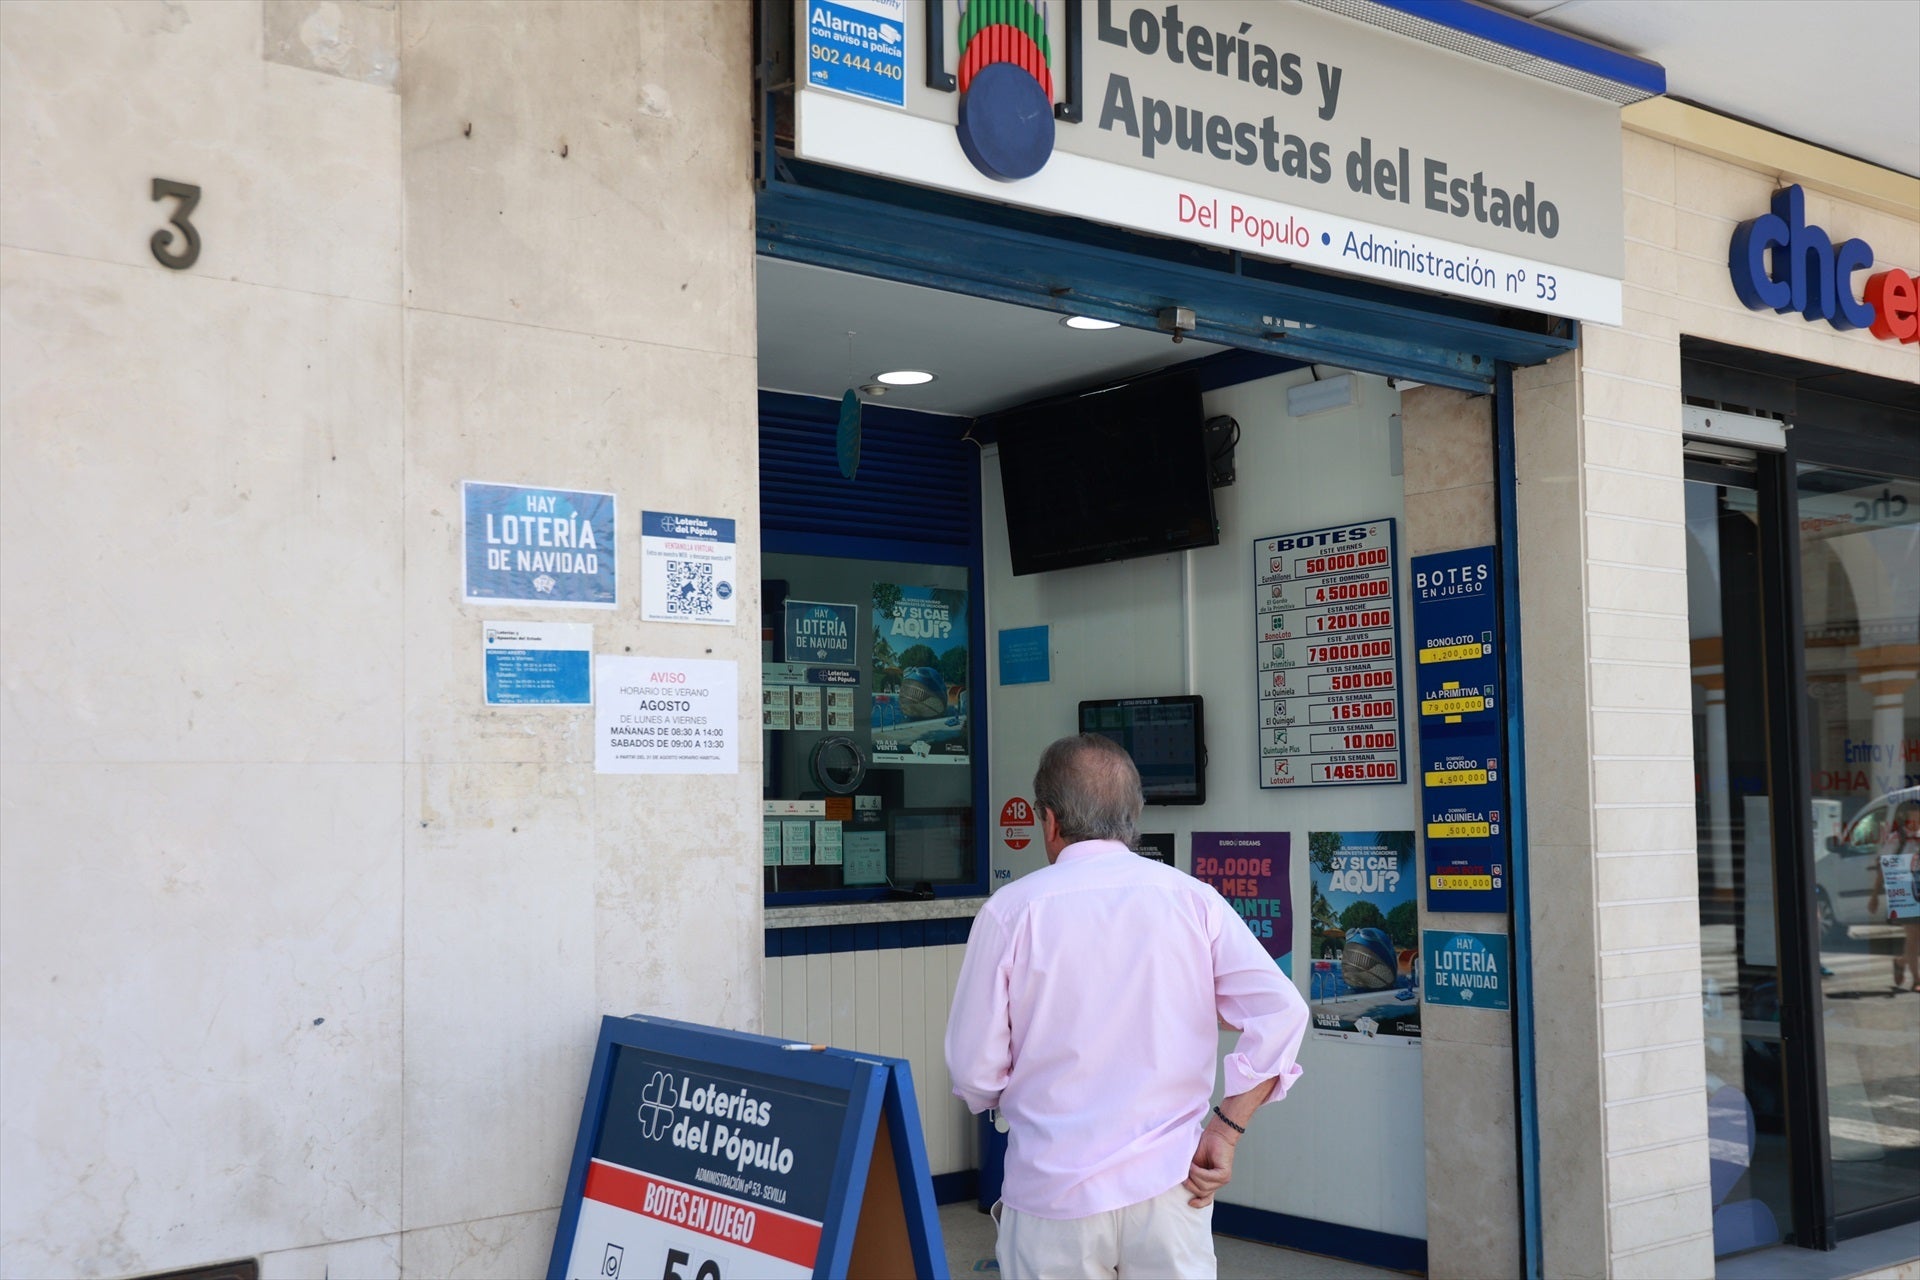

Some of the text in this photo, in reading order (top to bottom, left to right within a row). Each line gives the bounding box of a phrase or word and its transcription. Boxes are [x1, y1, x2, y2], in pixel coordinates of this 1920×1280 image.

[812, 8, 878, 41] Alarma
[811, 27, 831, 38] con
[833, 31, 860, 46] aviso
[862, 40, 868, 48] a
[811, 44, 902, 80] 902 444 440
[1098, 0, 1343, 121] Loterías y
[1099, 73, 1560, 239] Apuestas del Estado
[150, 178, 202, 270] 3
[1179, 194, 1558, 301] Del Populo Administración nº 53
[1728, 184, 1876, 332] chc
[526, 494, 556, 513] HAY
[486, 511, 597, 549] LOTERÍA
[675, 526, 688, 534] del
[1277, 528, 1367, 552] BOTES
[1320, 543, 1363, 556] ESTE VIERNES
[488, 549, 598, 575] DE NAVIDAD
[1339, 573, 1370, 582] DOMINGO
[1416, 564, 1488, 589] BOTES
[1422, 582, 1482, 598] EN JUEGO
[814, 609, 828, 618] HAY
[893, 606, 949, 620] ¿Y SI CAE
[1345, 603, 1366, 611] NOCHE
[796, 617, 847, 636] LOTERÍA
[890, 617, 952, 639] AQUÍ?
[796, 636, 848, 649] DE NAVIDAD
[1327, 633, 1369, 643] ESTE JUEVES
[1427, 634, 1474, 648] BONOLOTO
[1344, 663, 1372, 671] SEMANA
[650, 672, 686, 684] AVISO
[620, 686, 709, 697] HORARIO DE VERANO
[1272, 688, 1295, 696] Quiniela
[1345, 694, 1372, 702] SEMANA
[1426, 687, 1479, 700] LA PRIMITIVA
[640, 700, 690, 711] AGOSTO
[620, 715, 707, 725] DE LUNES A VIERNES
[1346, 723, 1374, 731] SEMANA
[610, 725, 723, 737] MAÑANAS DE 08:30 A 14:00
[610, 738, 724, 748] SABADOS DE 09:00 A 13:30
[1434, 760, 1477, 770] EL GORDO
[1006, 801, 1027, 820] +18
[1432, 811, 1484, 822] LA QUINIELA
[1196, 857, 1272, 877] 20.000€
[1331, 857, 1397, 870] ¿Y SI CAE
[994, 869, 1011, 879] VISA
[1329, 870, 1400, 894] AQUÍ?
[1222, 878, 1258, 897] MES
[1456, 939, 1473, 949] HAY
[1435, 948, 1497, 973] LOTERÍA
[1435, 972, 1498, 989] DE NAVIDAD
[679, 1077, 772, 1127] Loterias
[672, 1116, 794, 1174] del Pópulo
[695, 1167, 744, 1192] ADMINISTRACIÓN
[752, 1183, 761, 1196] 53
[763, 1185, 787, 1204] SEVILLA
[643, 1182, 756, 1244] BOTES EN JUEGO
